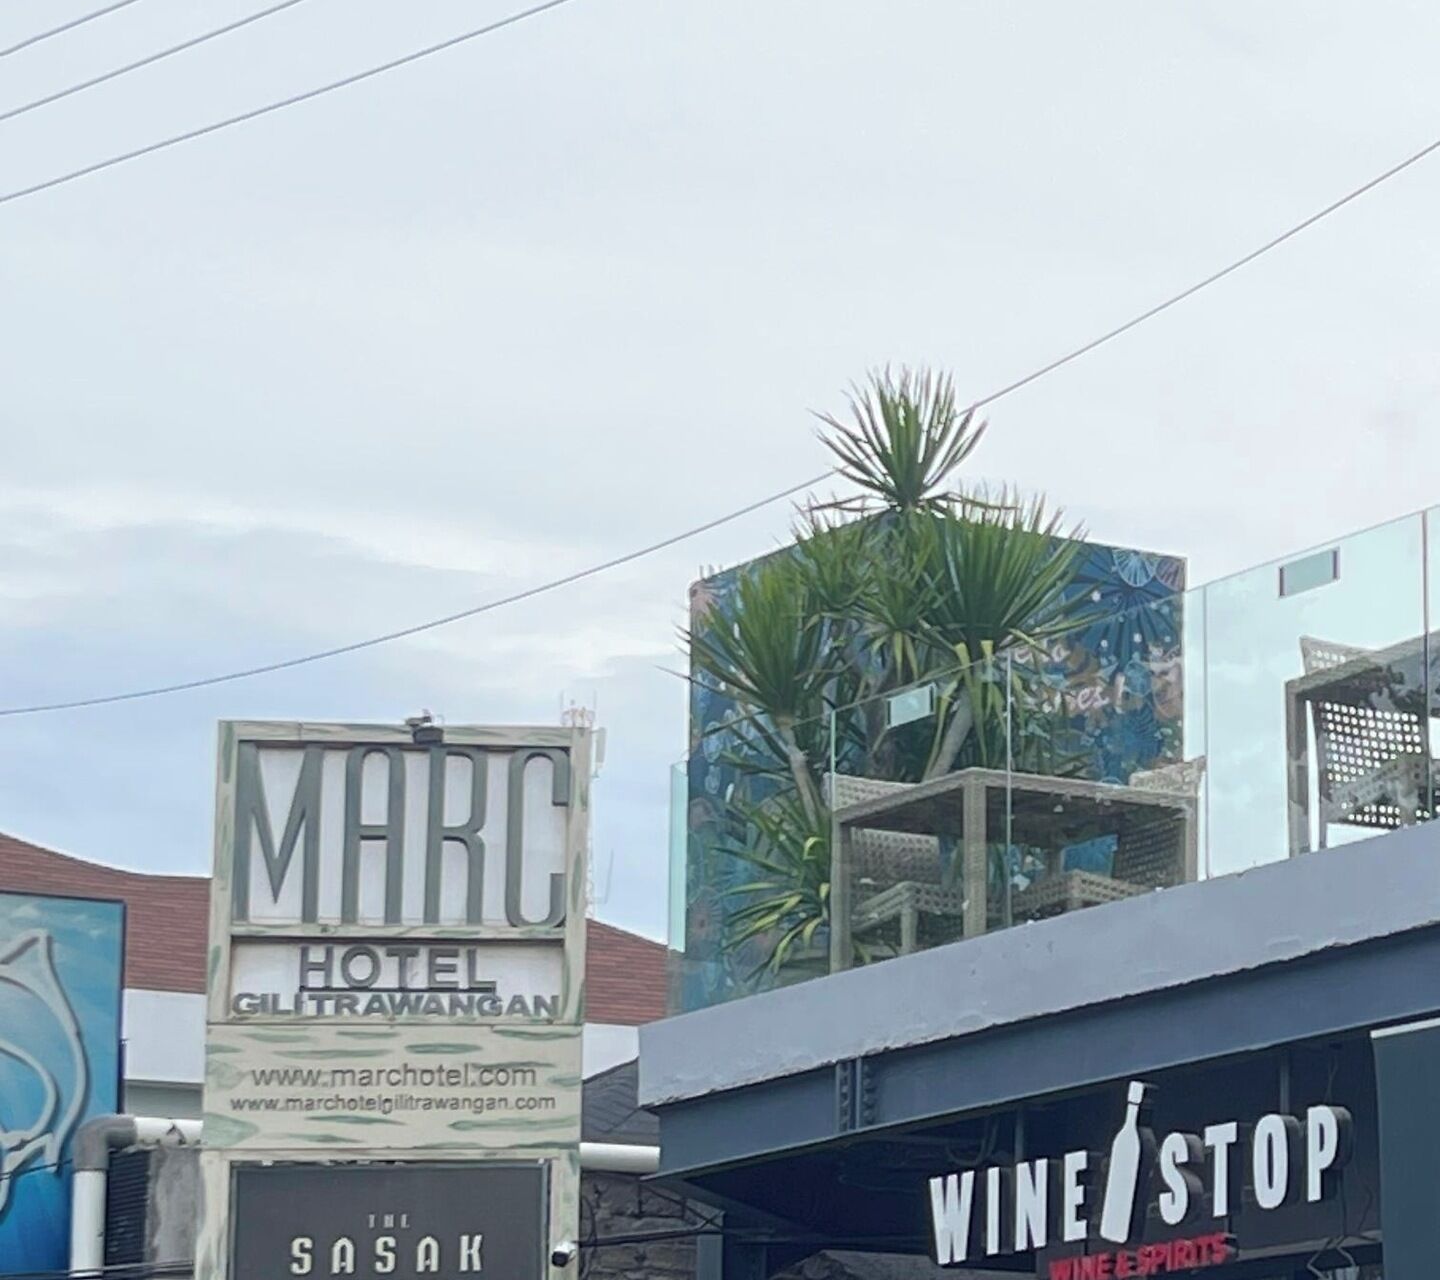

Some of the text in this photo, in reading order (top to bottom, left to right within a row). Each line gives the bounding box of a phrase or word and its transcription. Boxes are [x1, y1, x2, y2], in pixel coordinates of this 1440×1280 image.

[231, 741, 572, 928] MARC
[300, 946, 497, 991] HOTEL
[232, 992, 560, 1018] GILI TRAWANGAN
[251, 1063, 537, 1088] www.marchotel.com
[229, 1094, 556, 1115] www.marchotelgilitrawangan.com
[929, 1104, 1345, 1266] WINE STOP
[290, 1234, 483, 1275] SASAK
[1115, 1249, 1129, 1279] &
[1135, 1232, 1228, 1277] SPIRITS
